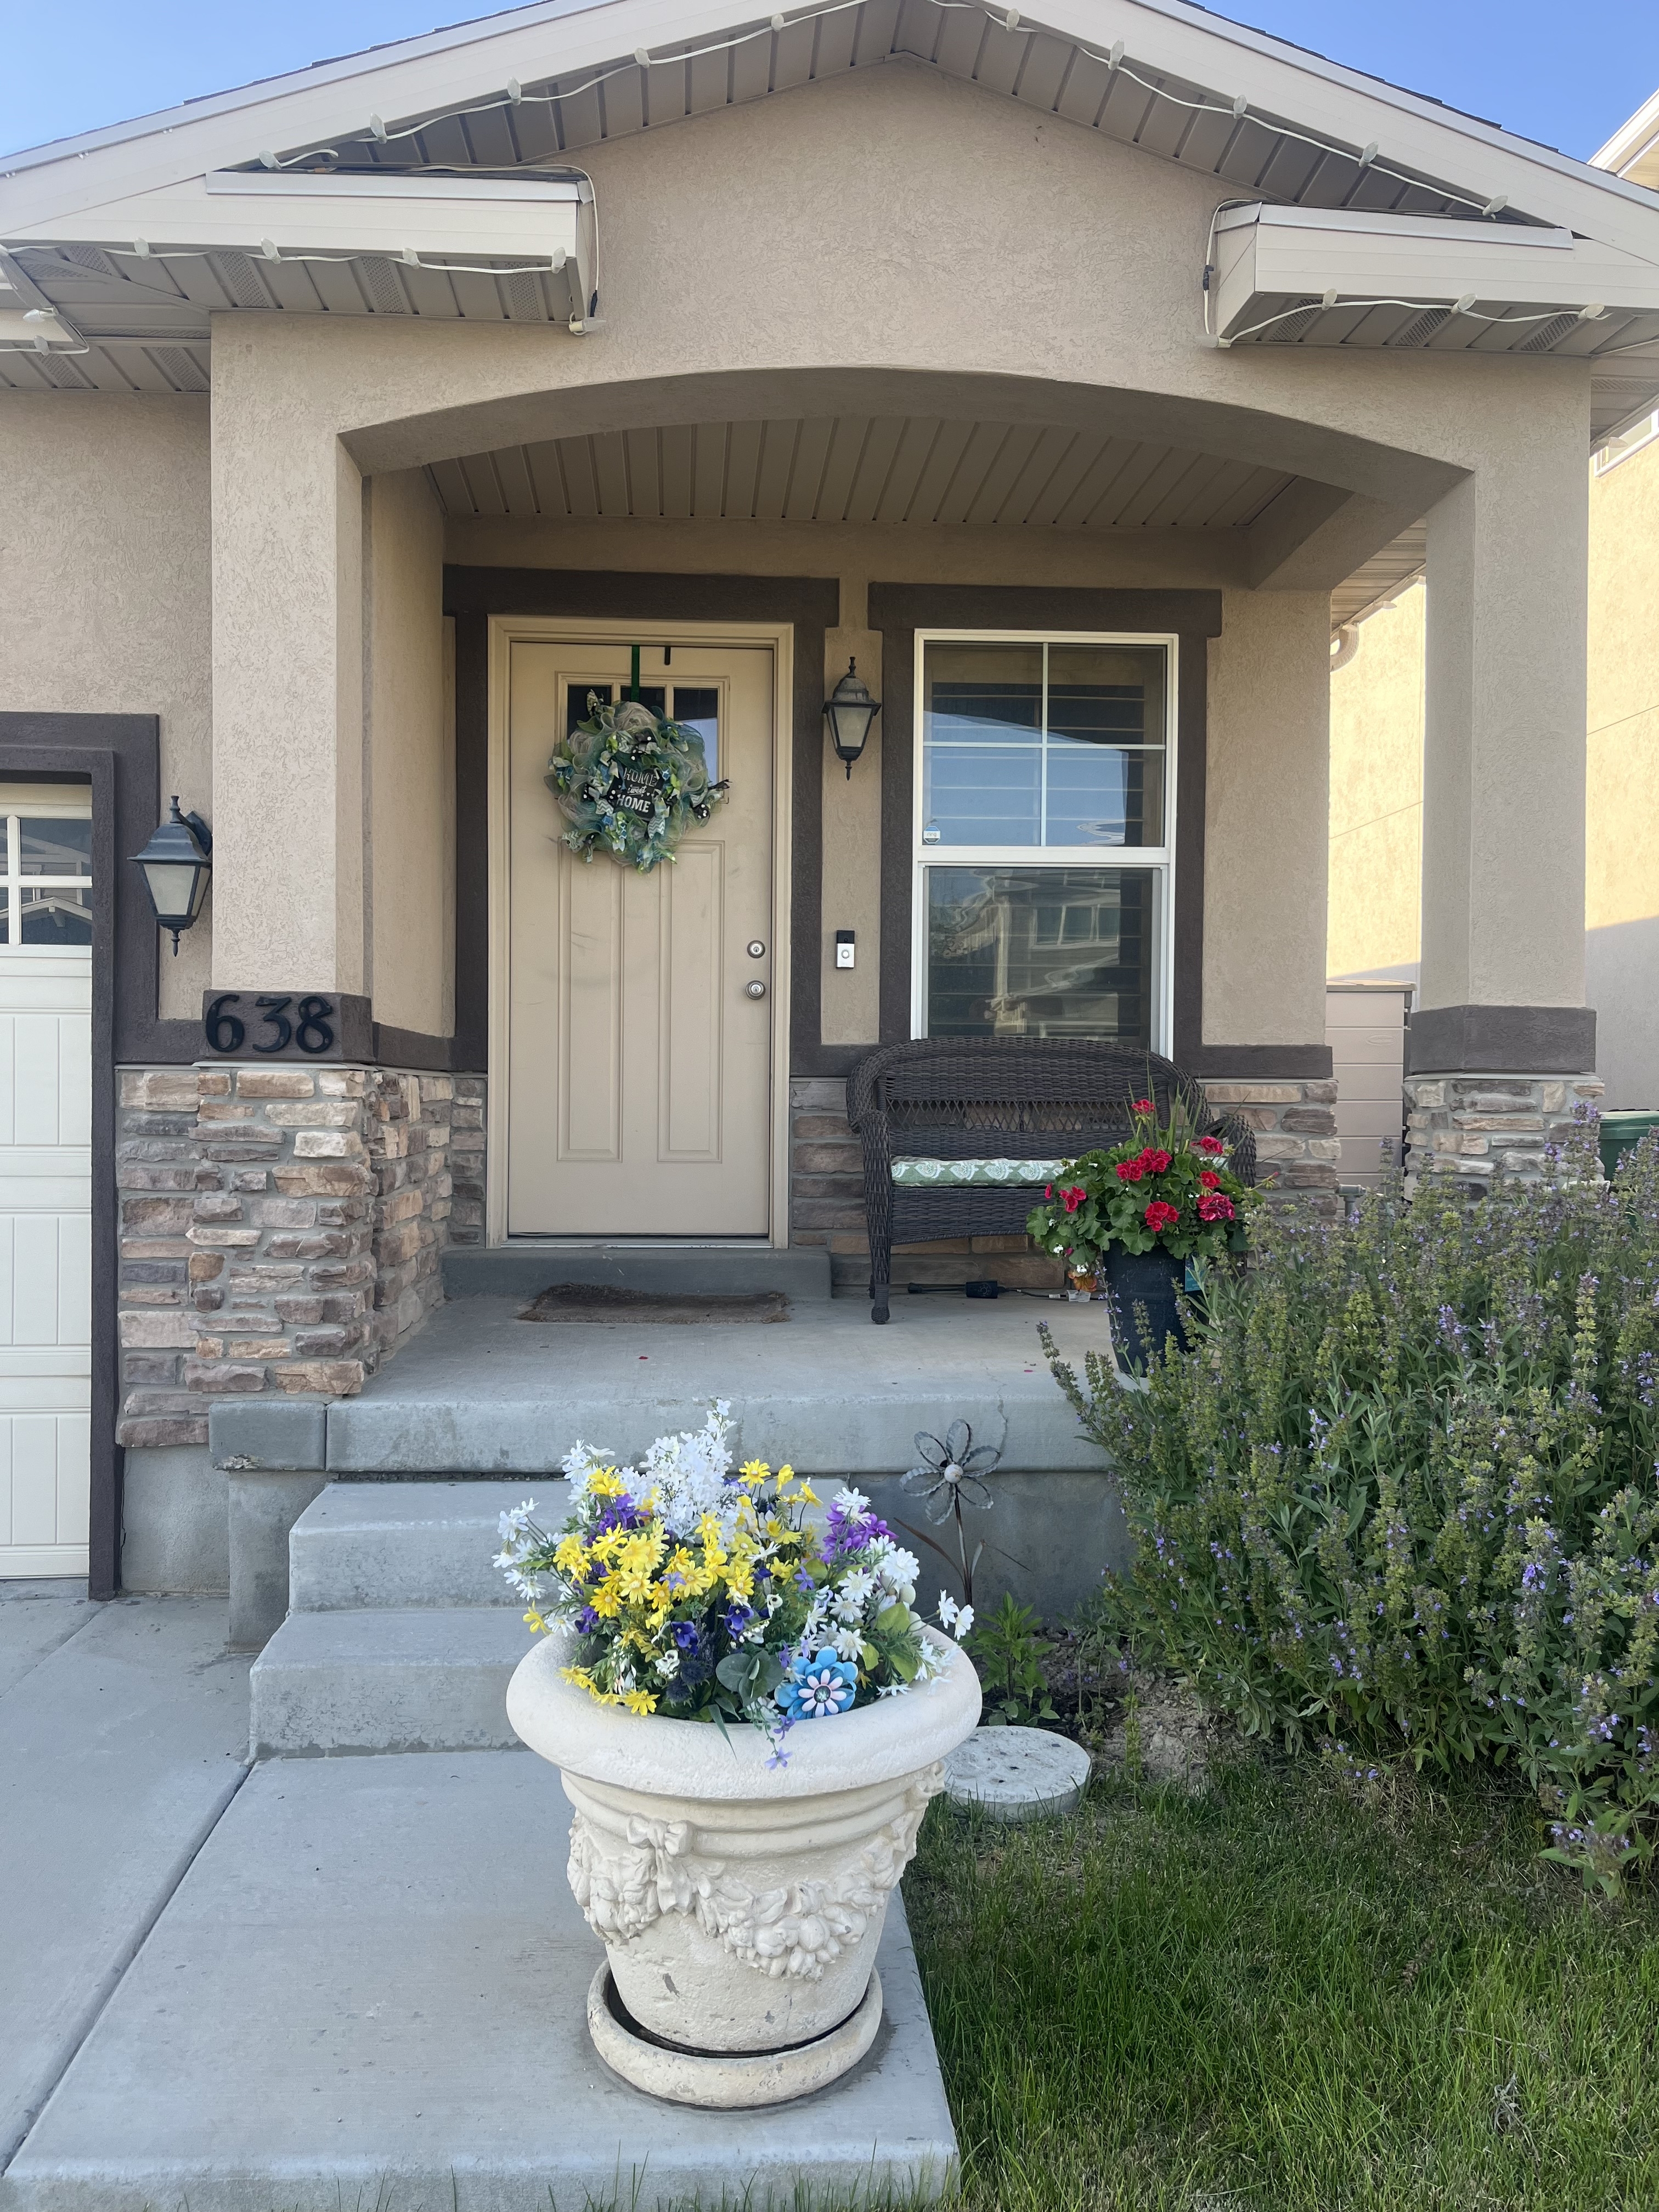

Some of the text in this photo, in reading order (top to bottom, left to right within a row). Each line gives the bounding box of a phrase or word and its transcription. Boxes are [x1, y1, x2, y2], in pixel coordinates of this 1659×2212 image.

[624, 768, 657, 787] HOME
[616, 795, 651, 812] HOME
[206, 994, 334, 1053] 638
